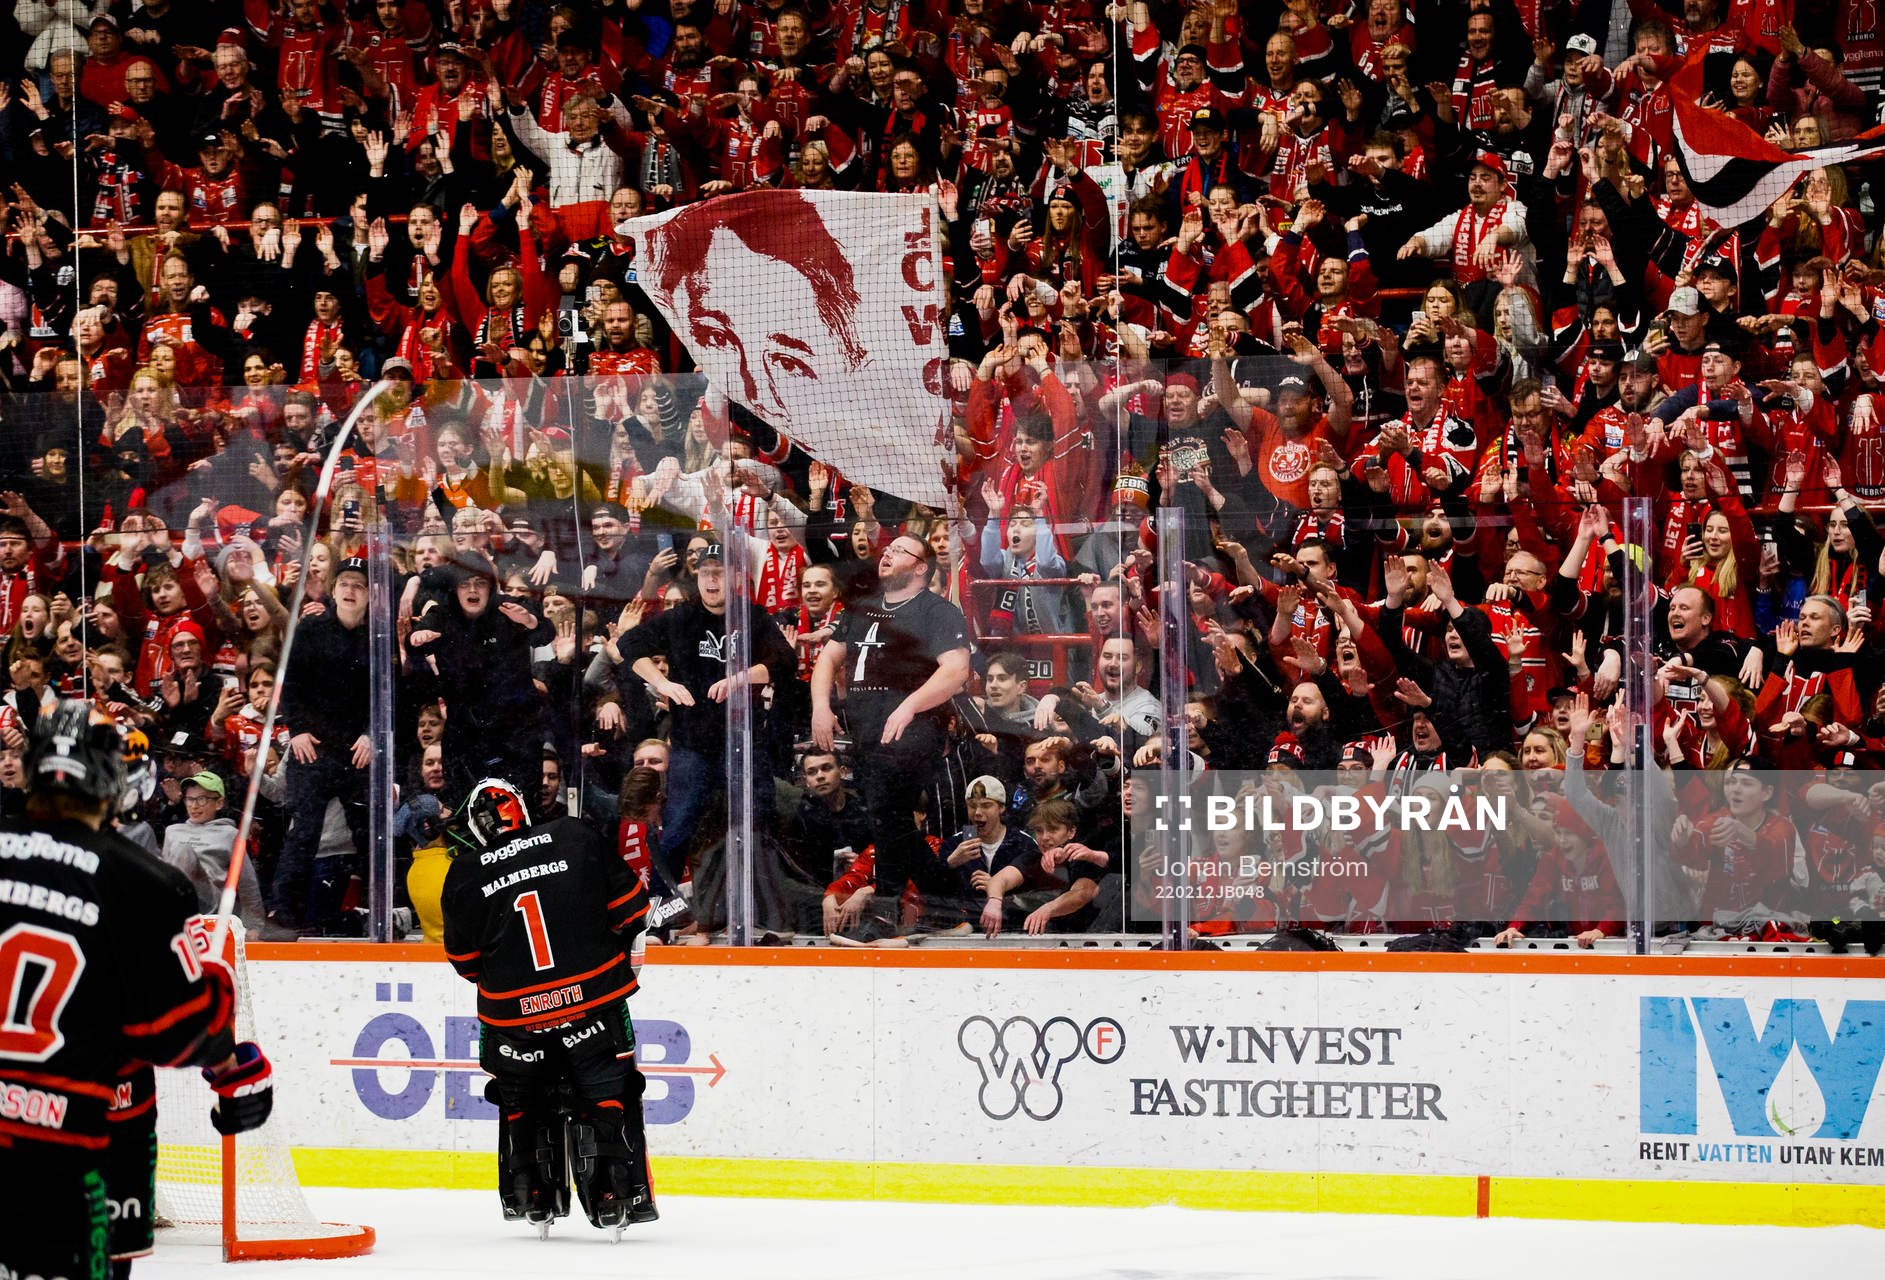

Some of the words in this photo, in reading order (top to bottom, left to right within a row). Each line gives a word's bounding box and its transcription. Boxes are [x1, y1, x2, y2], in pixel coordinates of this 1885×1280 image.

[481, 860, 568, 898] MALMBERGS
[171, 914, 209, 983] 15
[514, 890, 555, 972] 1
[520, 984, 584, 1015] ENROTH
[499, 1044, 545, 1063] elon
[562, 1020, 606, 1049] elon
[0, 1080, 69, 1130] SON
[1130, 1078, 1448, 1121] FASTIGHETER
[1640, 1142, 1690, 1160] RENT
[1697, 1144, 1772, 1163] VATTEN
[1780, 1146, 1832, 1165] UTAN
[1841, 1148, 1885, 1167] KEM
